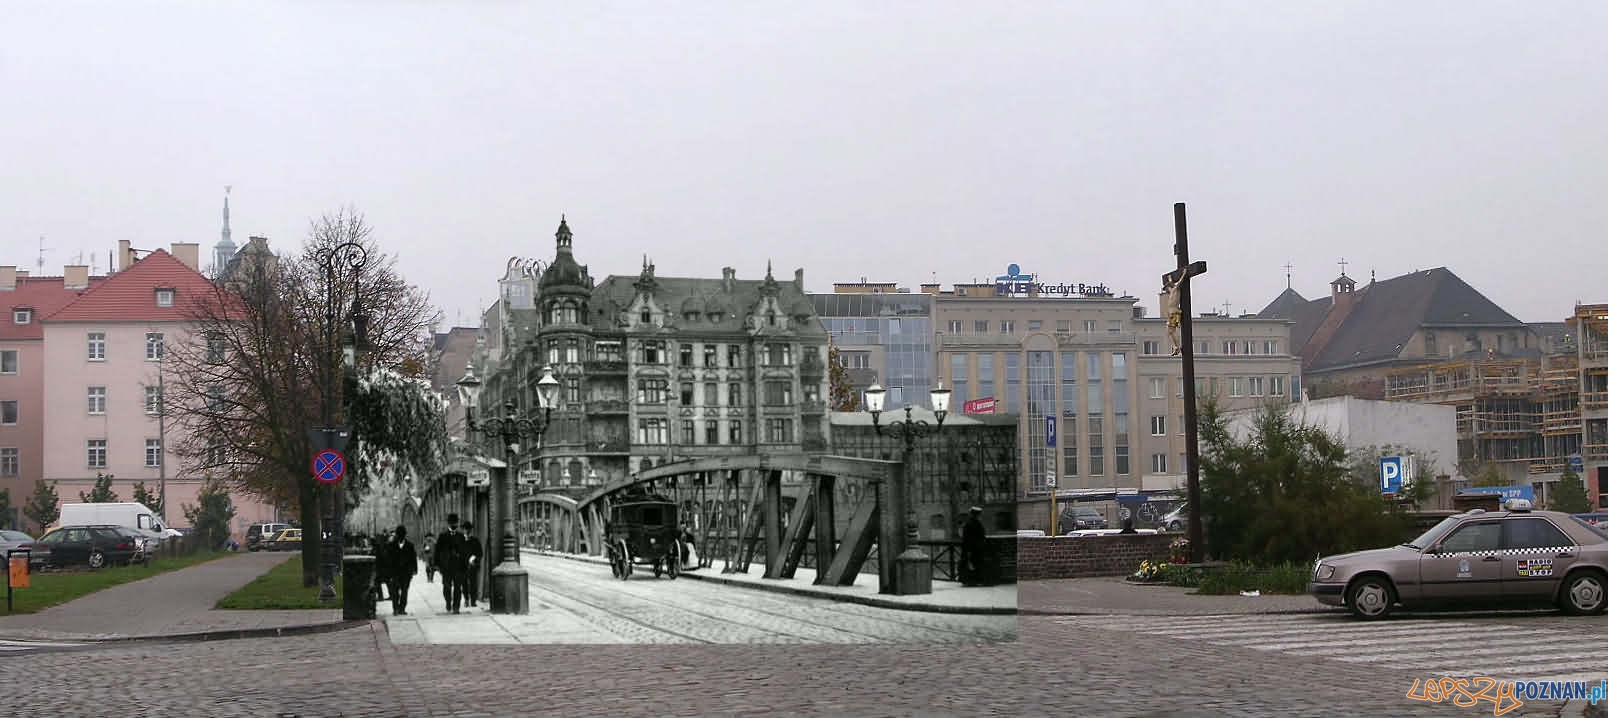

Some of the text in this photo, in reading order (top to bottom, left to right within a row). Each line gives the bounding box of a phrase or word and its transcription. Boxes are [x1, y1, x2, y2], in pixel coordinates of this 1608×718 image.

[1038, 282, 1106, 296] Kredyt Bank
[1382, 462, 1398, 489] P
